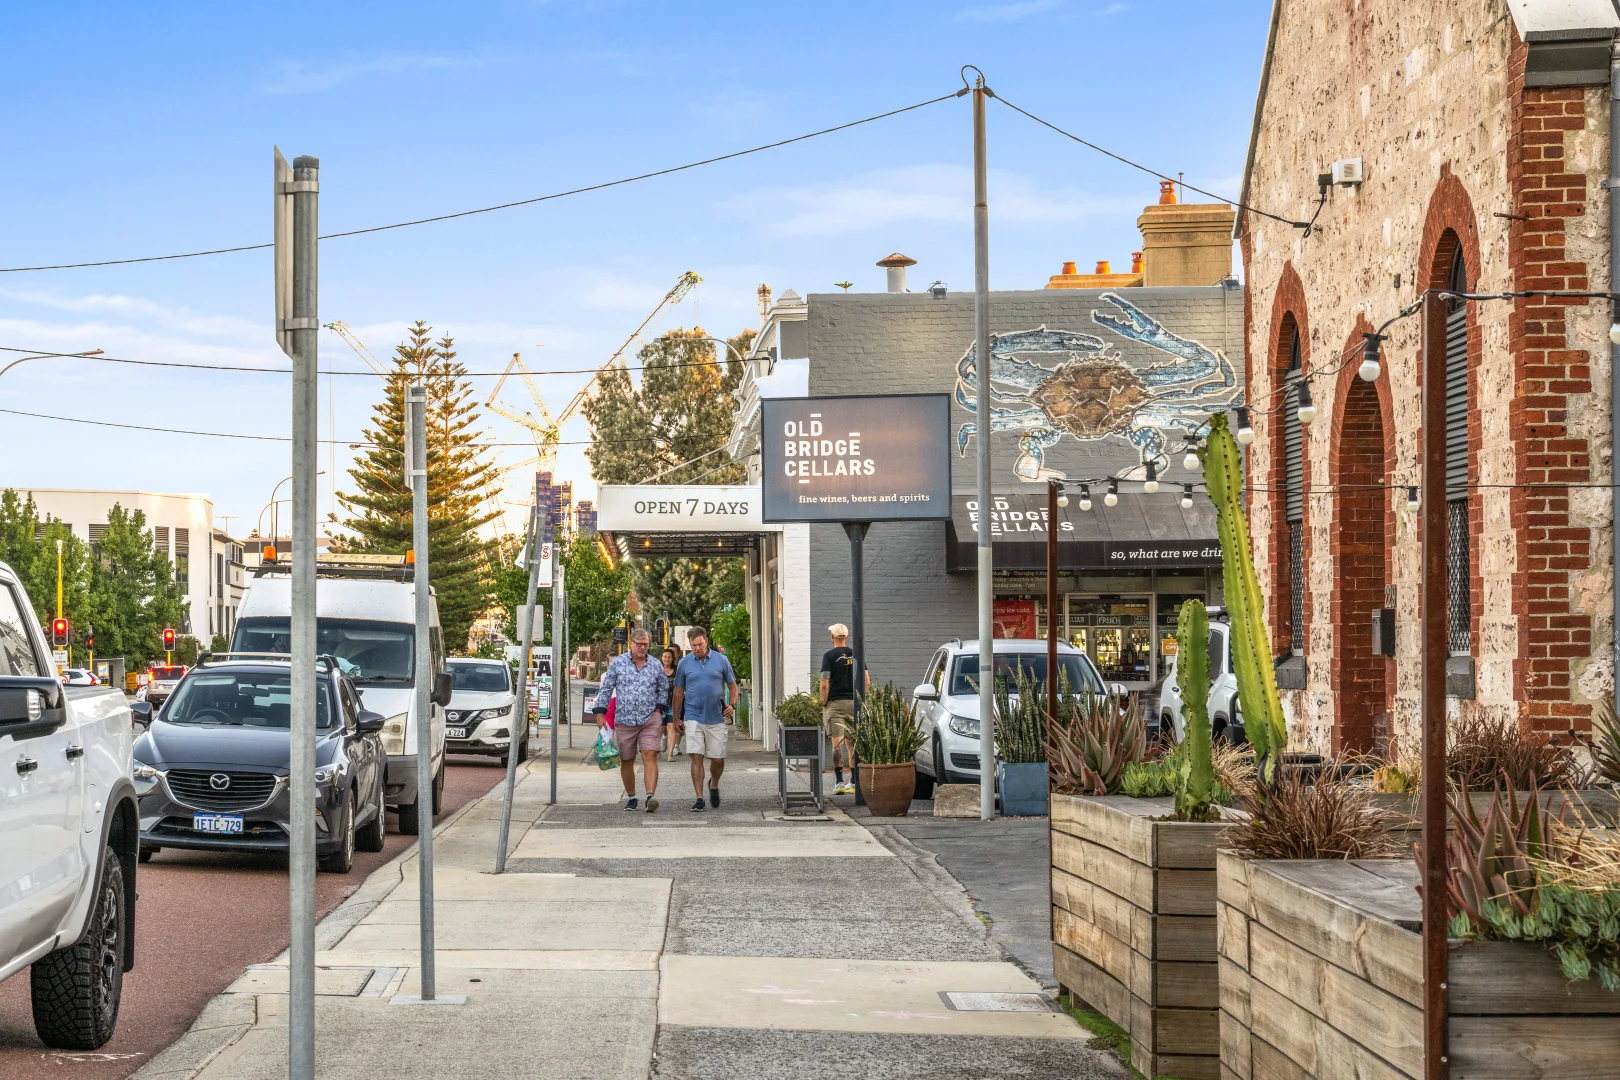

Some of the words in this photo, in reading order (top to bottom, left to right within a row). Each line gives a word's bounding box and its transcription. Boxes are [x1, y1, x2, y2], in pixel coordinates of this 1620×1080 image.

[784, 420, 823, 437] OLD
[784, 439, 861, 457] BRIDGE
[784, 458, 876, 477] CELLARS
[798, 495, 818, 504] fine
[819, 494, 850, 504] wines,
[851, 494, 878, 503] beers
[879, 493, 897, 502] and
[899, 493, 931, 504] spirits
[966, 500, 1010, 511] OD
[634, 501, 682, 514] OPEN
[686, 498, 700, 517] 7
[703, 501, 749, 515] DAYS
[971, 521, 1075, 532] CELLAS
[1111, 551, 1126, 561] so,
[1128, 548, 1159, 559] what
[1182, 549, 1199, 558] we
